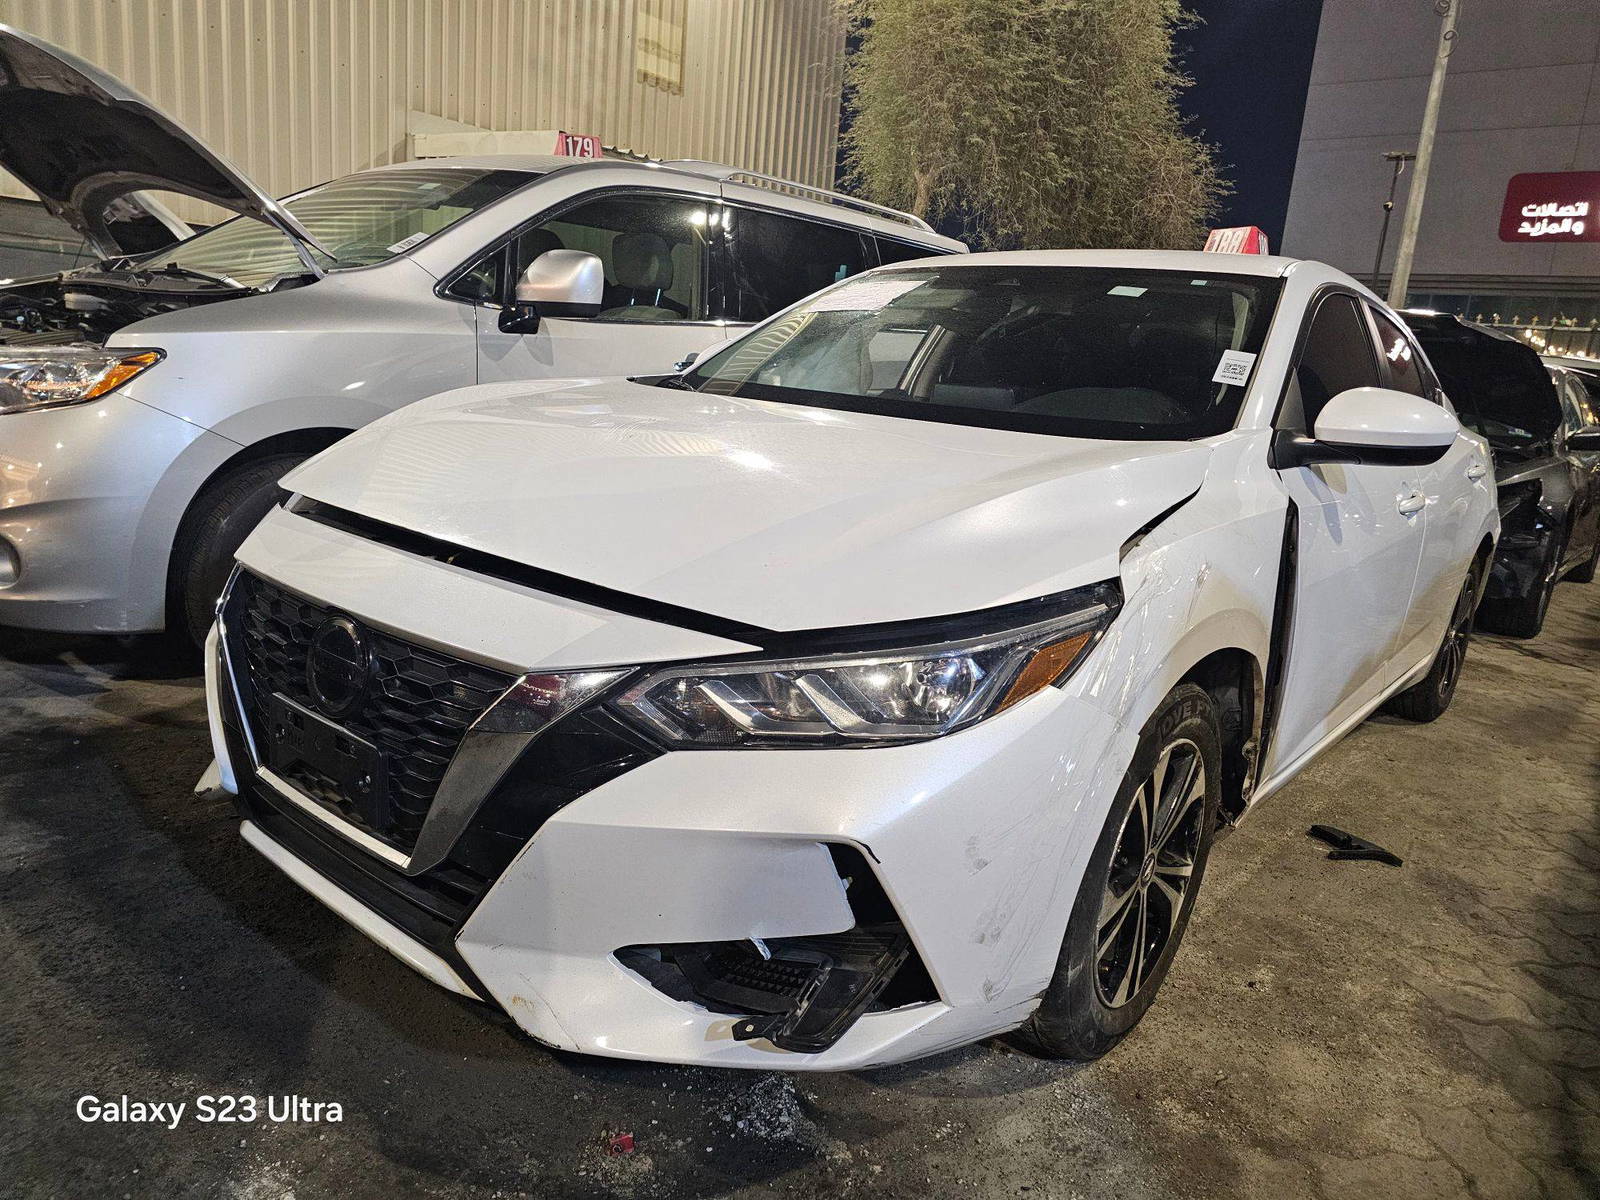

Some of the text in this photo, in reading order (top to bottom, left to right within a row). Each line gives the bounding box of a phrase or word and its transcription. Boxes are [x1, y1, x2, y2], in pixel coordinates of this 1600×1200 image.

[566, 136, 594, 159] 179
[1521, 201, 1589, 217] اتصالات
[1517, 217, 1585, 237] والمزيد
